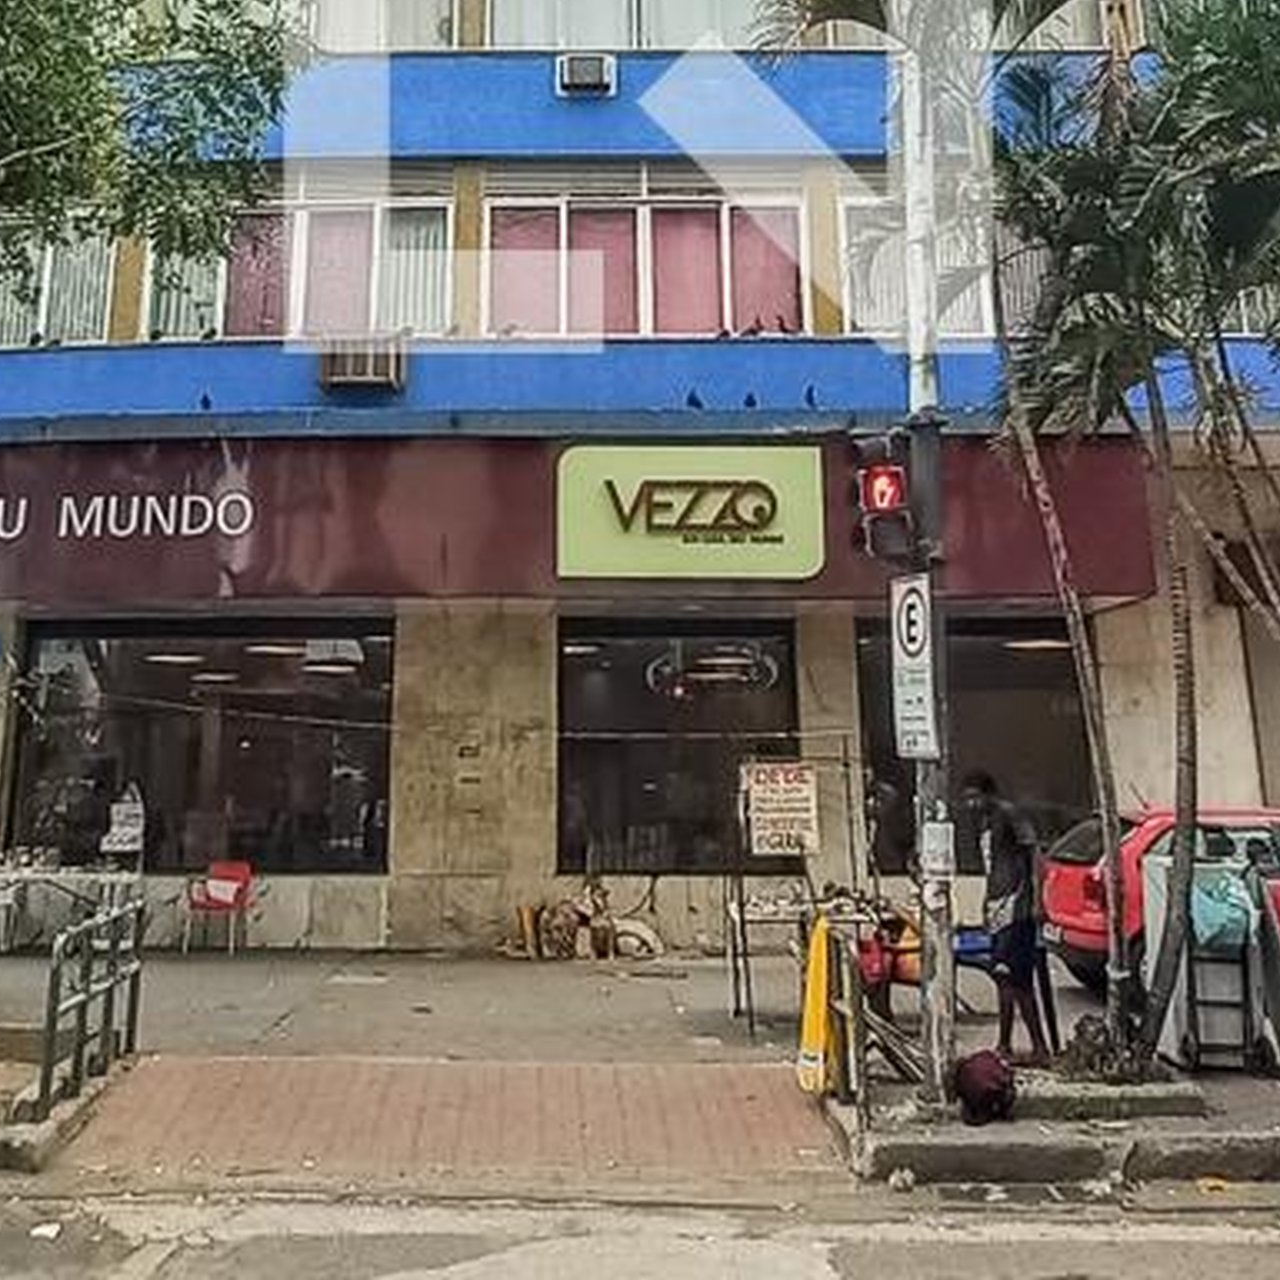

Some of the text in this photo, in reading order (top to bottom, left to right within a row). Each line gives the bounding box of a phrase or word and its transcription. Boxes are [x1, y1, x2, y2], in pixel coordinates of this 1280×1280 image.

[57, 493, 254, 538] MUNDO
[604, 479, 778, 533] VEZZO
[905, 602, 919, 644] E
